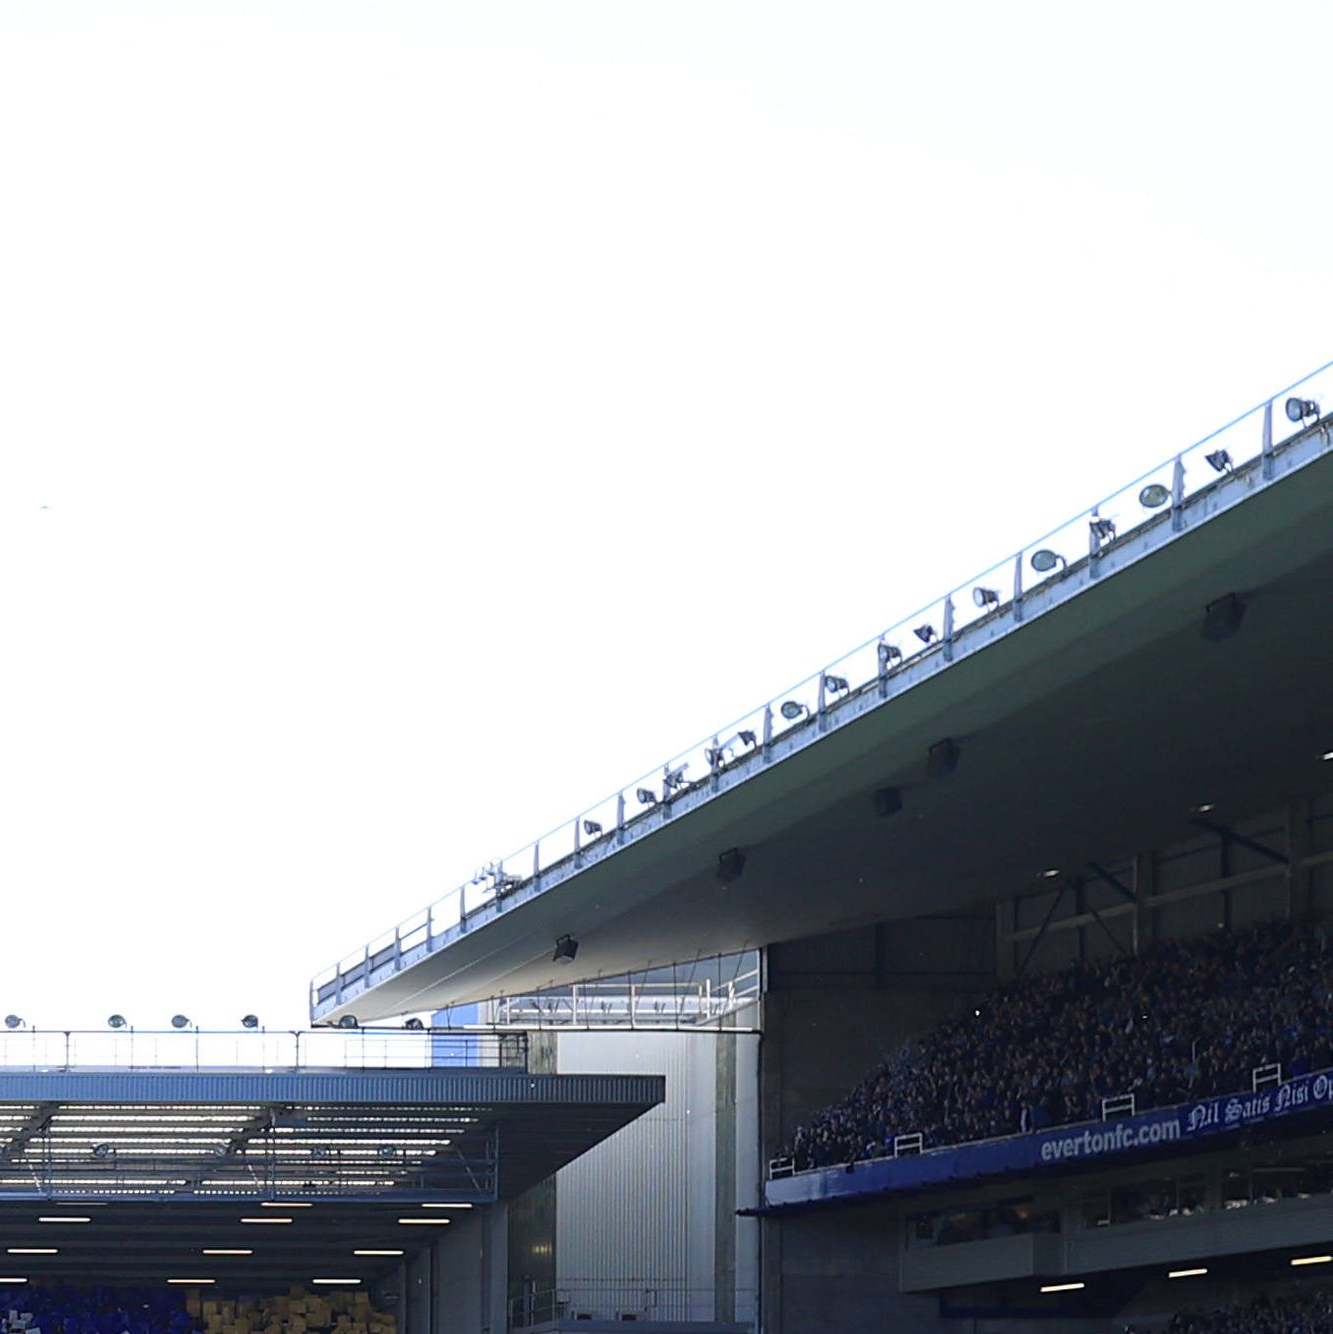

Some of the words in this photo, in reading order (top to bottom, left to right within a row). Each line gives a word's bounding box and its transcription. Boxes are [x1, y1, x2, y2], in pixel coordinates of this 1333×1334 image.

[1186, 1102, 1219, 1131] Nil
[1225, 1093, 1271, 1124] Satis
[1041, 1119, 1181, 1160] evertonfc.com
